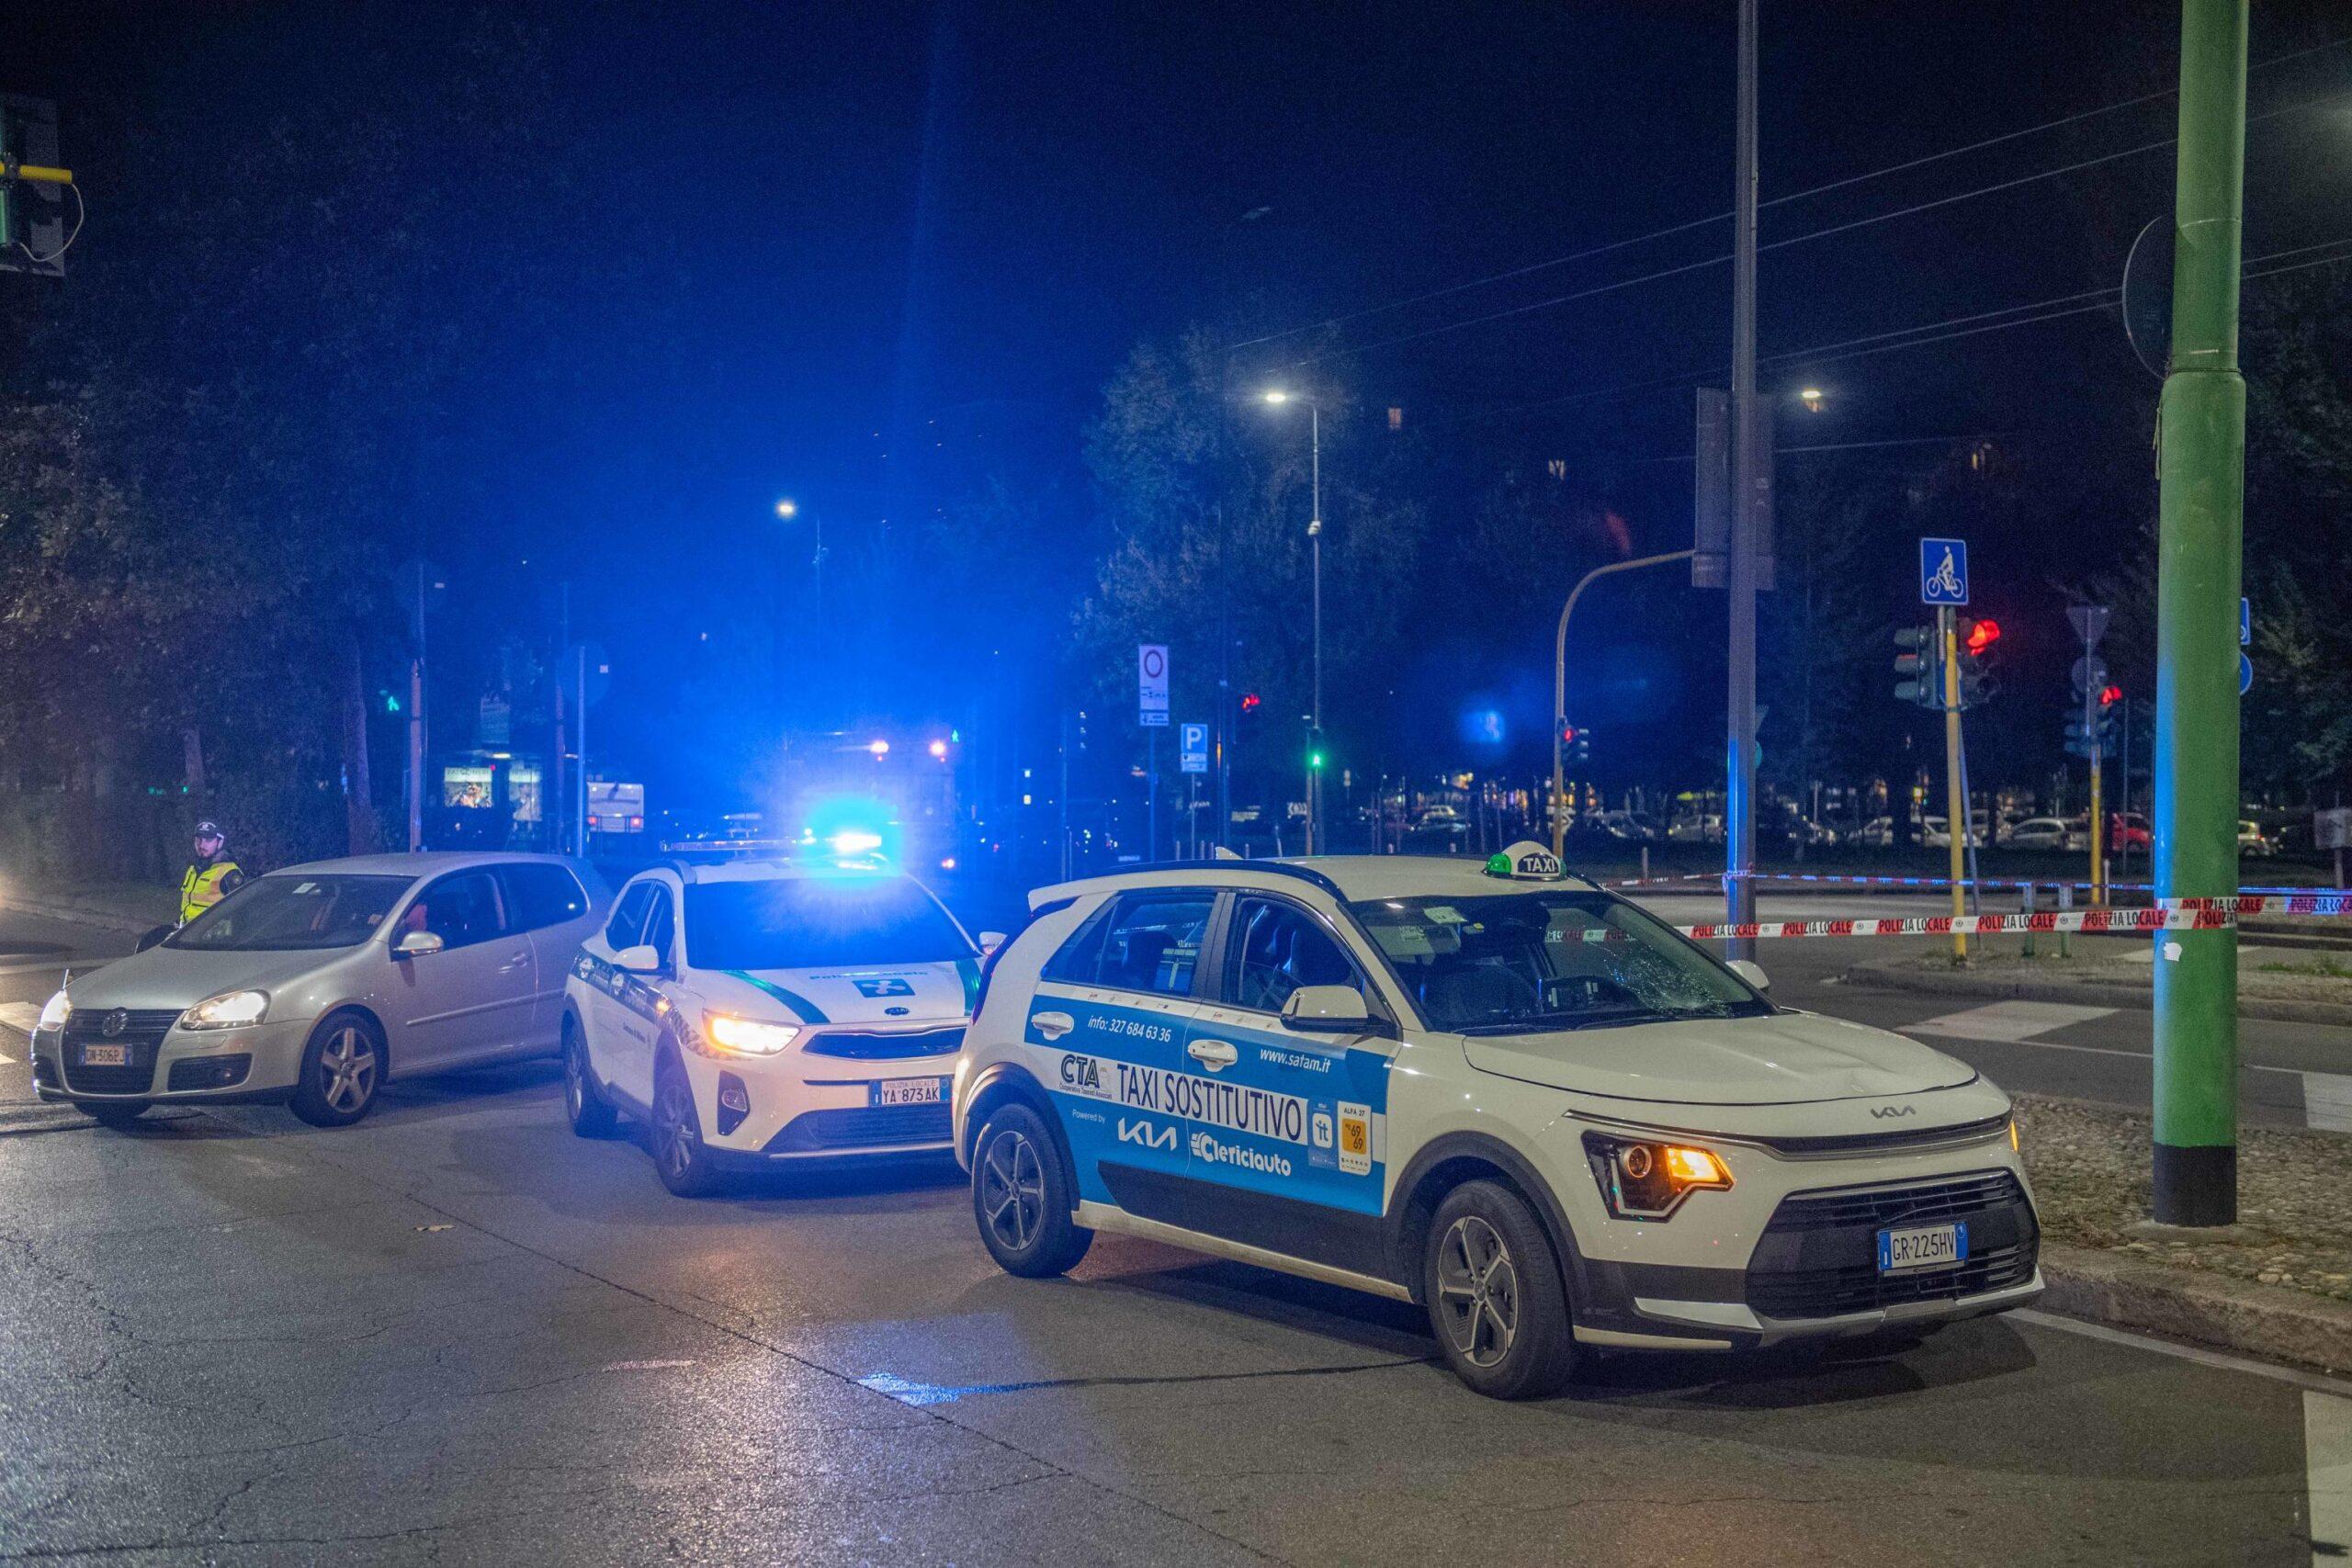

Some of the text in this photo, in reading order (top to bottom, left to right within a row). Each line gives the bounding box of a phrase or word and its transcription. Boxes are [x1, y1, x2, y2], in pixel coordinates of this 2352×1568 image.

[1186, 727, 1203, 750] P
[1523, 858, 1555, 873] TAXI
[2226, 897, 2261, 911] LOCALE
[2290, 898, 2328, 912] POLIZIA
[1879, 918, 1951, 932] POLIZIA LOCALE
[1979, 913, 2053, 930] POLIZIA LOCALE
[2085, 909, 2165, 927] POLIZIA LOCALE
[1693, 923, 1758, 937] POLIZIA LOCALE
[1783, 920, 1852, 935] POLIZIA LOCALE
[1088, 1015, 1172, 1043] info: 327 684 63 36
[1260, 1049, 1331, 1073] www.satam.it
[1061, 1054, 1101, 1089] CTA
[1117, 1063, 1302, 1142] TAXI SOSTITUTIVO
[1072, 1108, 1106, 1125] Powered by
[1343, 1107, 1365, 1118] ALFA 27
[1351, 1125, 1362, 1138] 69
[1353, 1138, 1363, 1151] 69
[1200, 1133, 1293, 1177] Clericiauto
